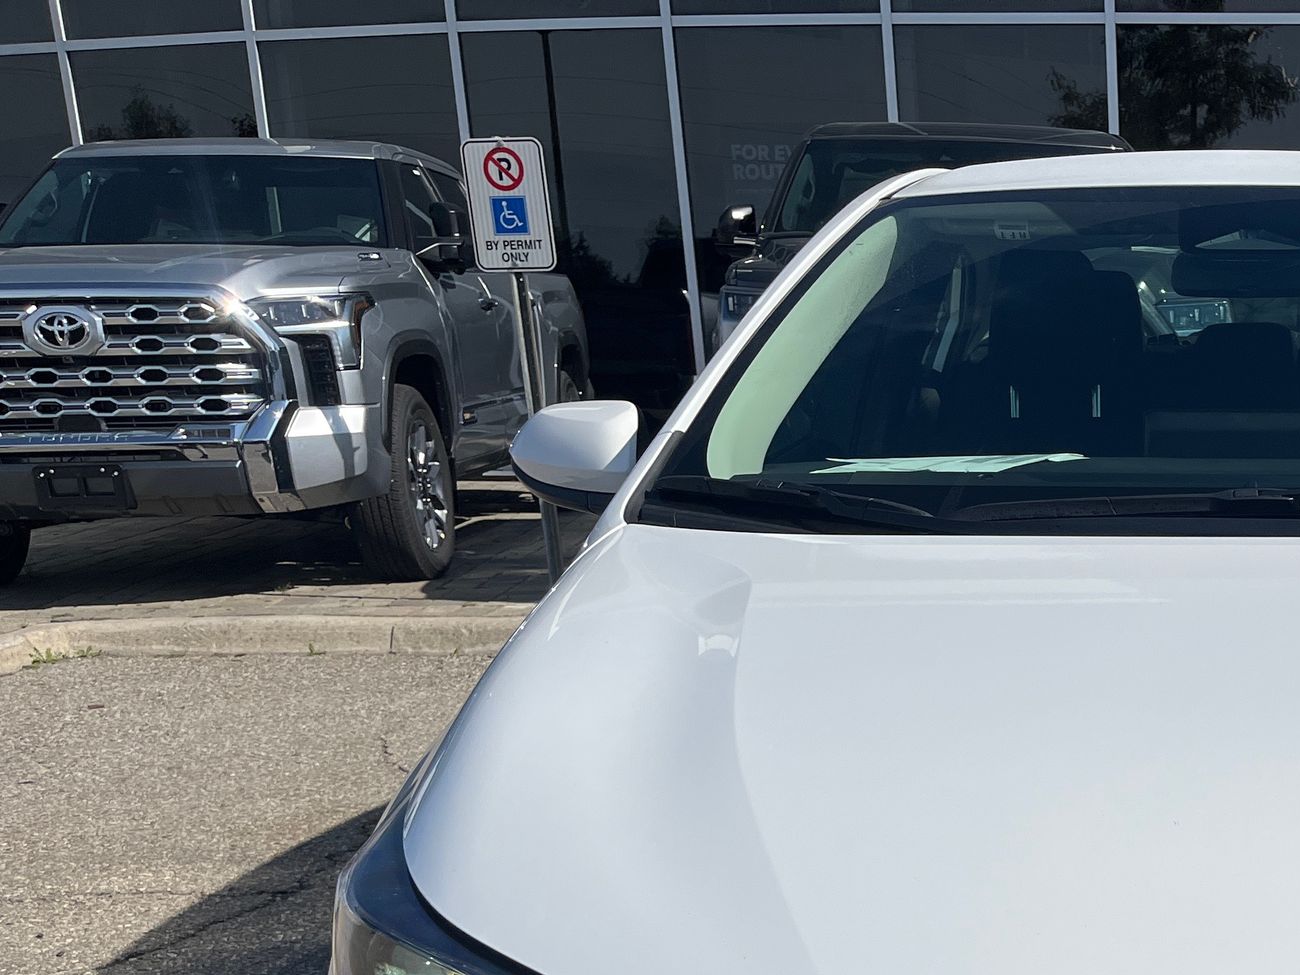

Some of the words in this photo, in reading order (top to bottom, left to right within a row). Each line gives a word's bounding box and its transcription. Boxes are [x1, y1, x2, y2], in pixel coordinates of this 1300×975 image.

[731, 144, 770, 161] FOR
[733, 164, 786, 181] ROUT
[486, 240, 499, 250] BY
[503, 239, 543, 250] PERMIT
[501, 252, 530, 263] ONLY
